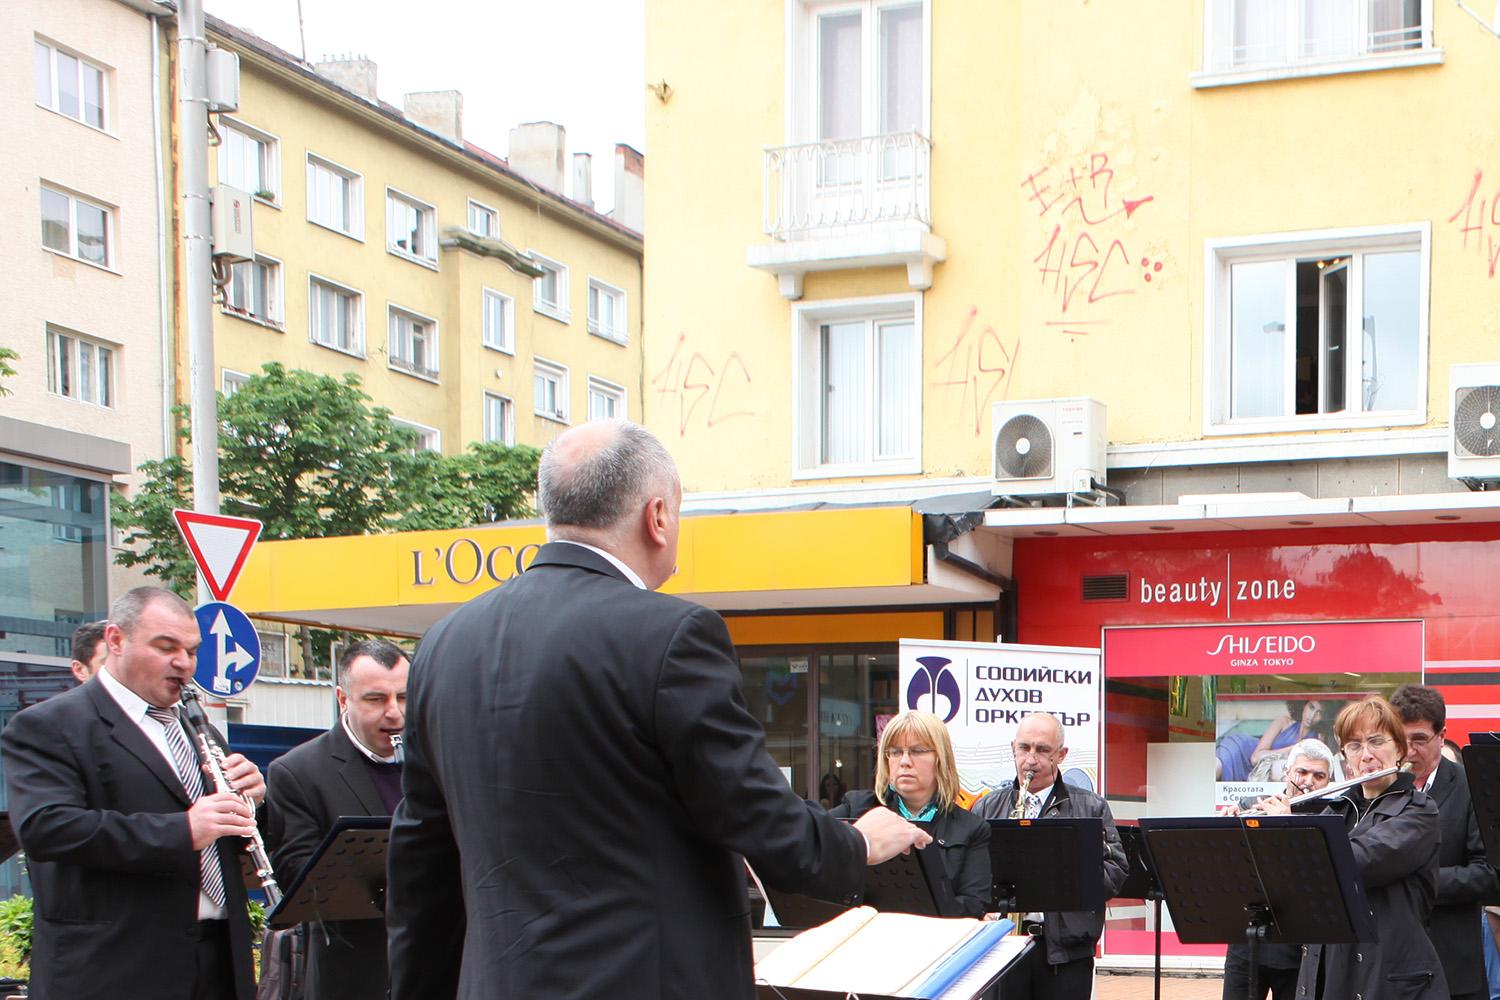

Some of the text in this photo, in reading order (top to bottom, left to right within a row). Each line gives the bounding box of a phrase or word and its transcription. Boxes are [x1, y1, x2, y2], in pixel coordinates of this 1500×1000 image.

[1140, 576, 1295, 607] beauty zone
[1206, 634, 1316, 656] SHISEIDO
[1230, 658, 1294, 667] GINZA TOKYO
[975, 665, 1092, 684] СОФИЙСКИ
[975, 687, 1043, 703] ДУХОВ
[975, 708, 1091, 726] ОРКЪР
